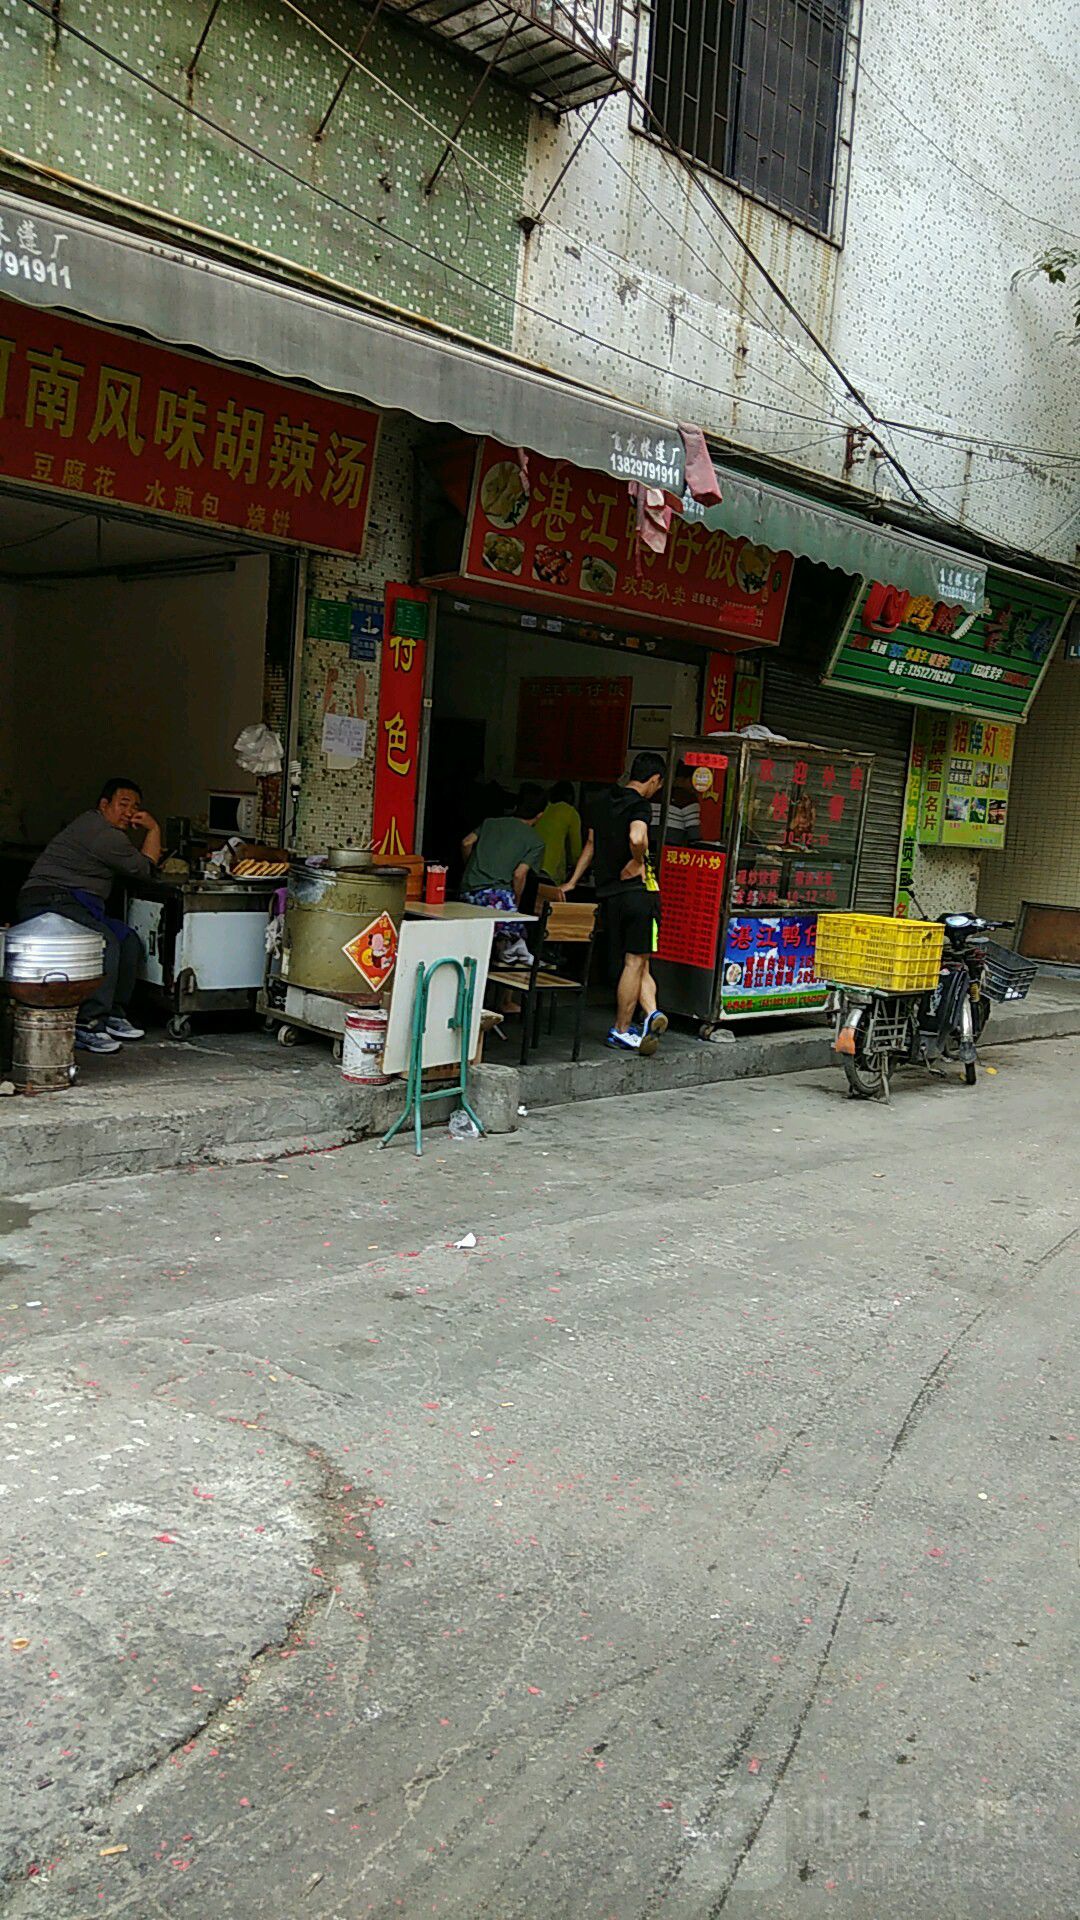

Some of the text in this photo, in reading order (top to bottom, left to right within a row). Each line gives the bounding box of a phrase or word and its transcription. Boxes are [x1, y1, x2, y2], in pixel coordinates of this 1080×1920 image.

[0, 249, 72, 290] 91911
[609, 453, 681, 486] 13829791911
[31, 451, 293, 539] 豆腐花 水煎包 烧饼
[622, 576, 687, 607] 欢迎外卖
[666, 850, 722, 870] 现炒/小炒
